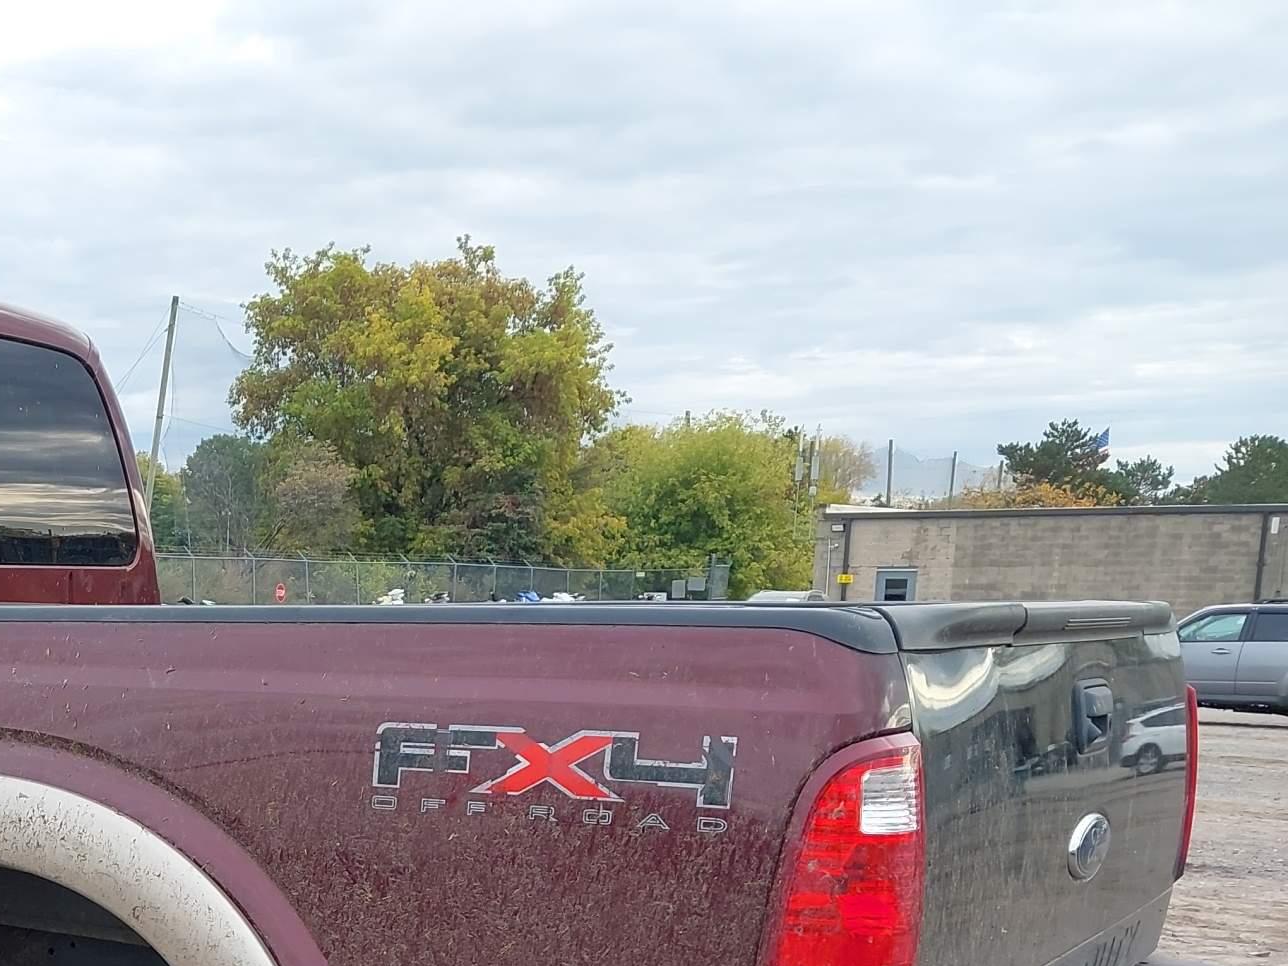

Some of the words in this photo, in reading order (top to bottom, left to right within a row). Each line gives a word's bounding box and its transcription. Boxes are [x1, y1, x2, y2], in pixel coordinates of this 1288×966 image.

[372, 721, 738, 809] FX4
[371, 795, 488, 816] OFF
[528, 804, 728, 833] ROAD
